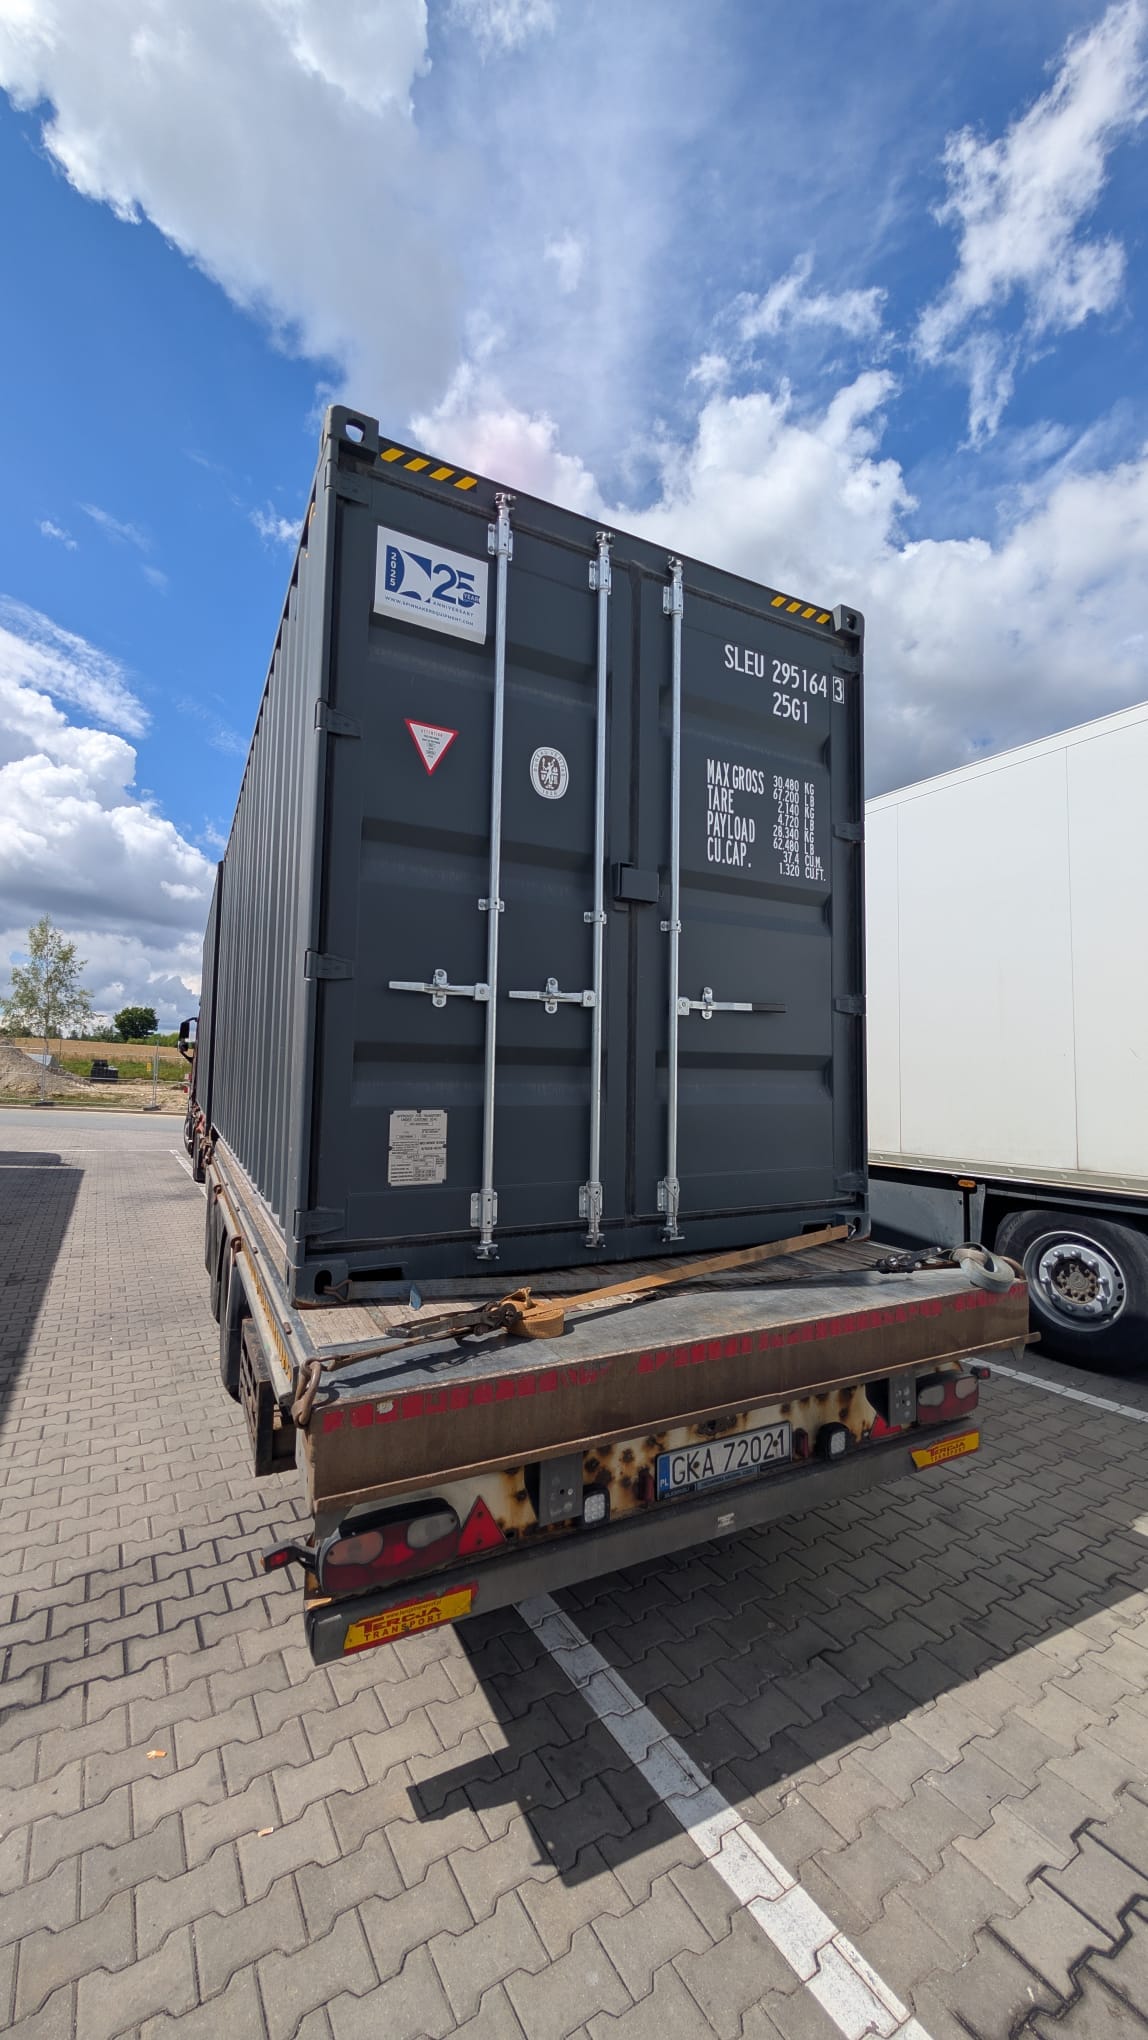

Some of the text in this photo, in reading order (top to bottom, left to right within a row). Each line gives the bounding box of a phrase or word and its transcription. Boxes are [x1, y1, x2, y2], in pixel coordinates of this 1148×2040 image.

[432, 564, 475, 608] 25
[433, 602, 474, 617] ANNIVERSARY
[725, 644, 843, 701] SLEU 295164 3
[773, 691, 808, 724] 25G1
[707, 758, 815, 796] MAX GROSS 30.480 KG
[707, 784, 815, 820] TARE 2.140 KG
[773, 787, 800, 804] 67.200
[707, 810, 815, 844] PAYLOAD 28.340 KG
[777, 813, 800, 829] 4.720
[773, 836, 800, 854] 62.480
[783, 850, 800, 865] 37.4
[779, 862, 800, 878] 1.320
[660, 1478, 668, 1488] PL
[671, 1450, 715, 1485] GKA
[723, 1428, 785, 1473] 72021
[356, 1606, 442, 1633] TERCJA
[364, 1612, 441, 1641] TRANSPORT
